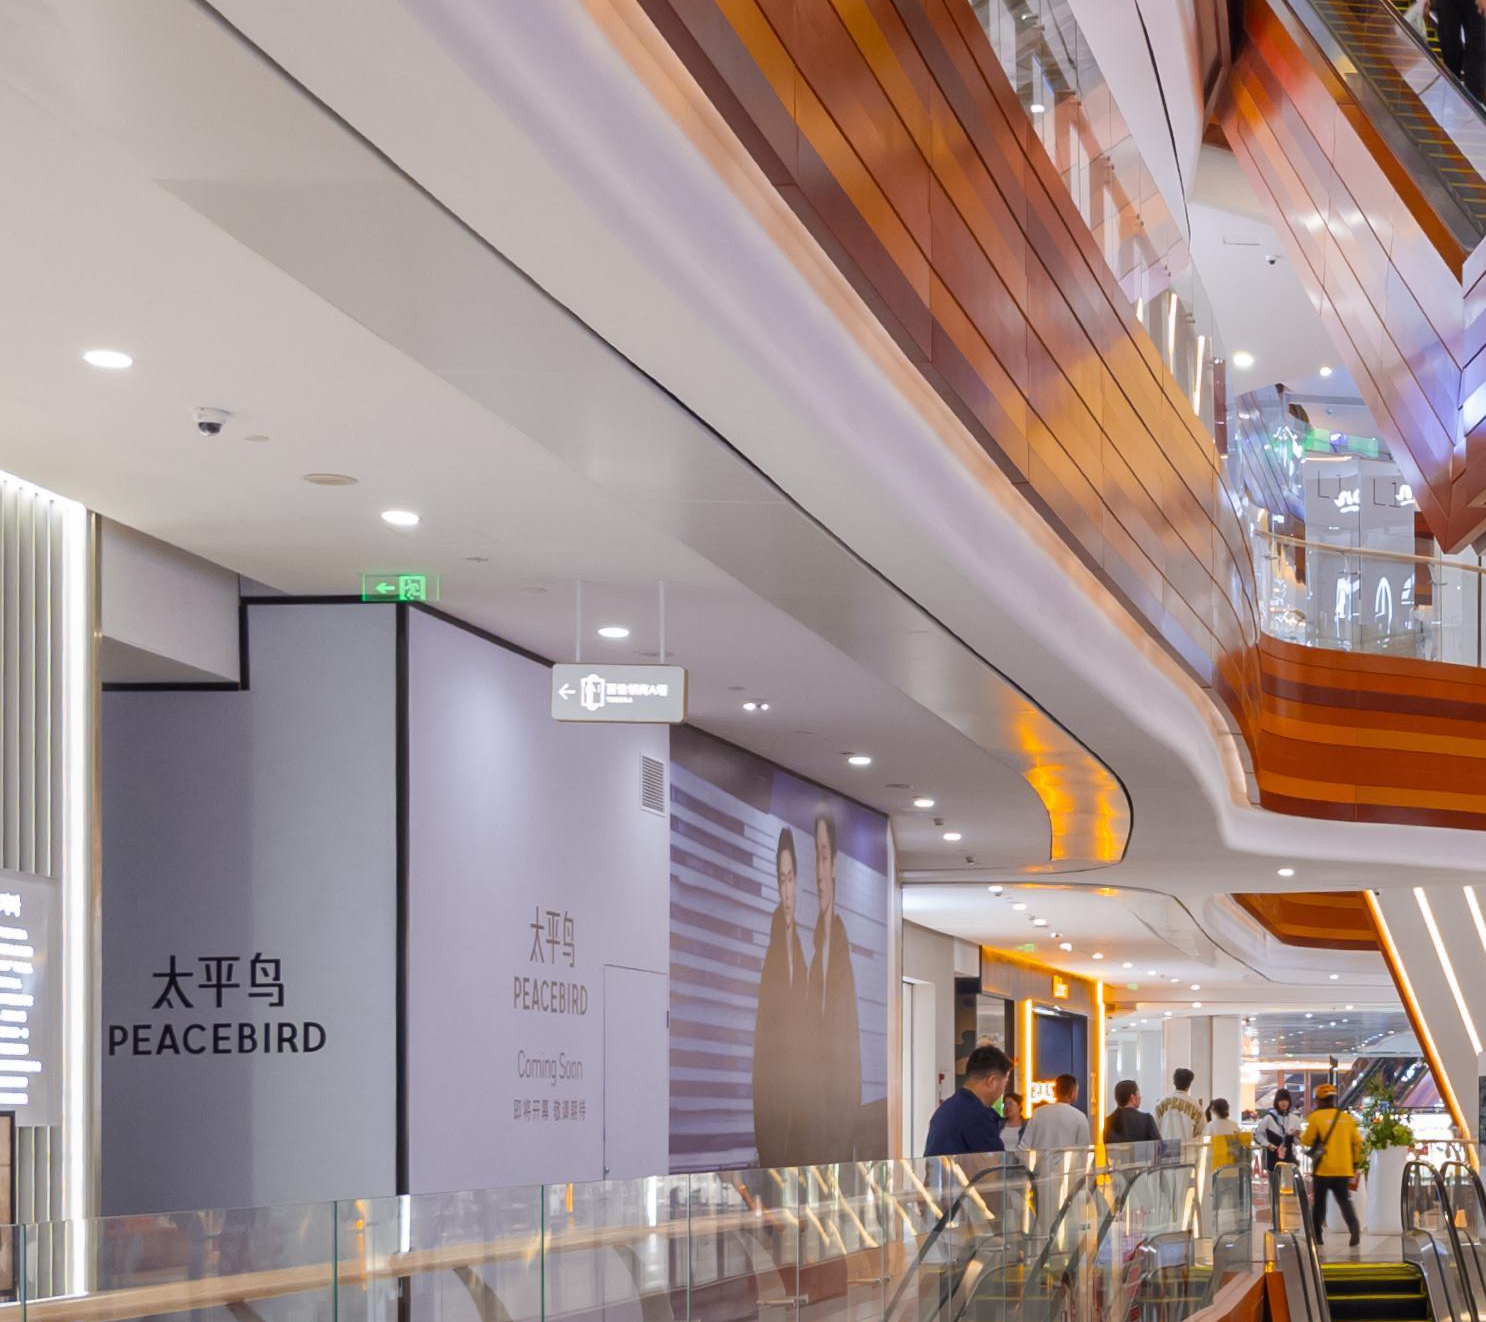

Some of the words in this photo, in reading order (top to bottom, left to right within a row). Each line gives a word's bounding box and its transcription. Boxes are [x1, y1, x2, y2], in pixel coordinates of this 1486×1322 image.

[530, 906, 575, 968] 太平鸟
[152, 952, 285, 1010] 太平鸟
[513, 976, 589, 1016] PEACEBIRD
[108, 1021, 327, 1056] PEACEBIRD
[517, 1049, 557, 1087] Coming
[559, 1052, 583, 1081] Soon
